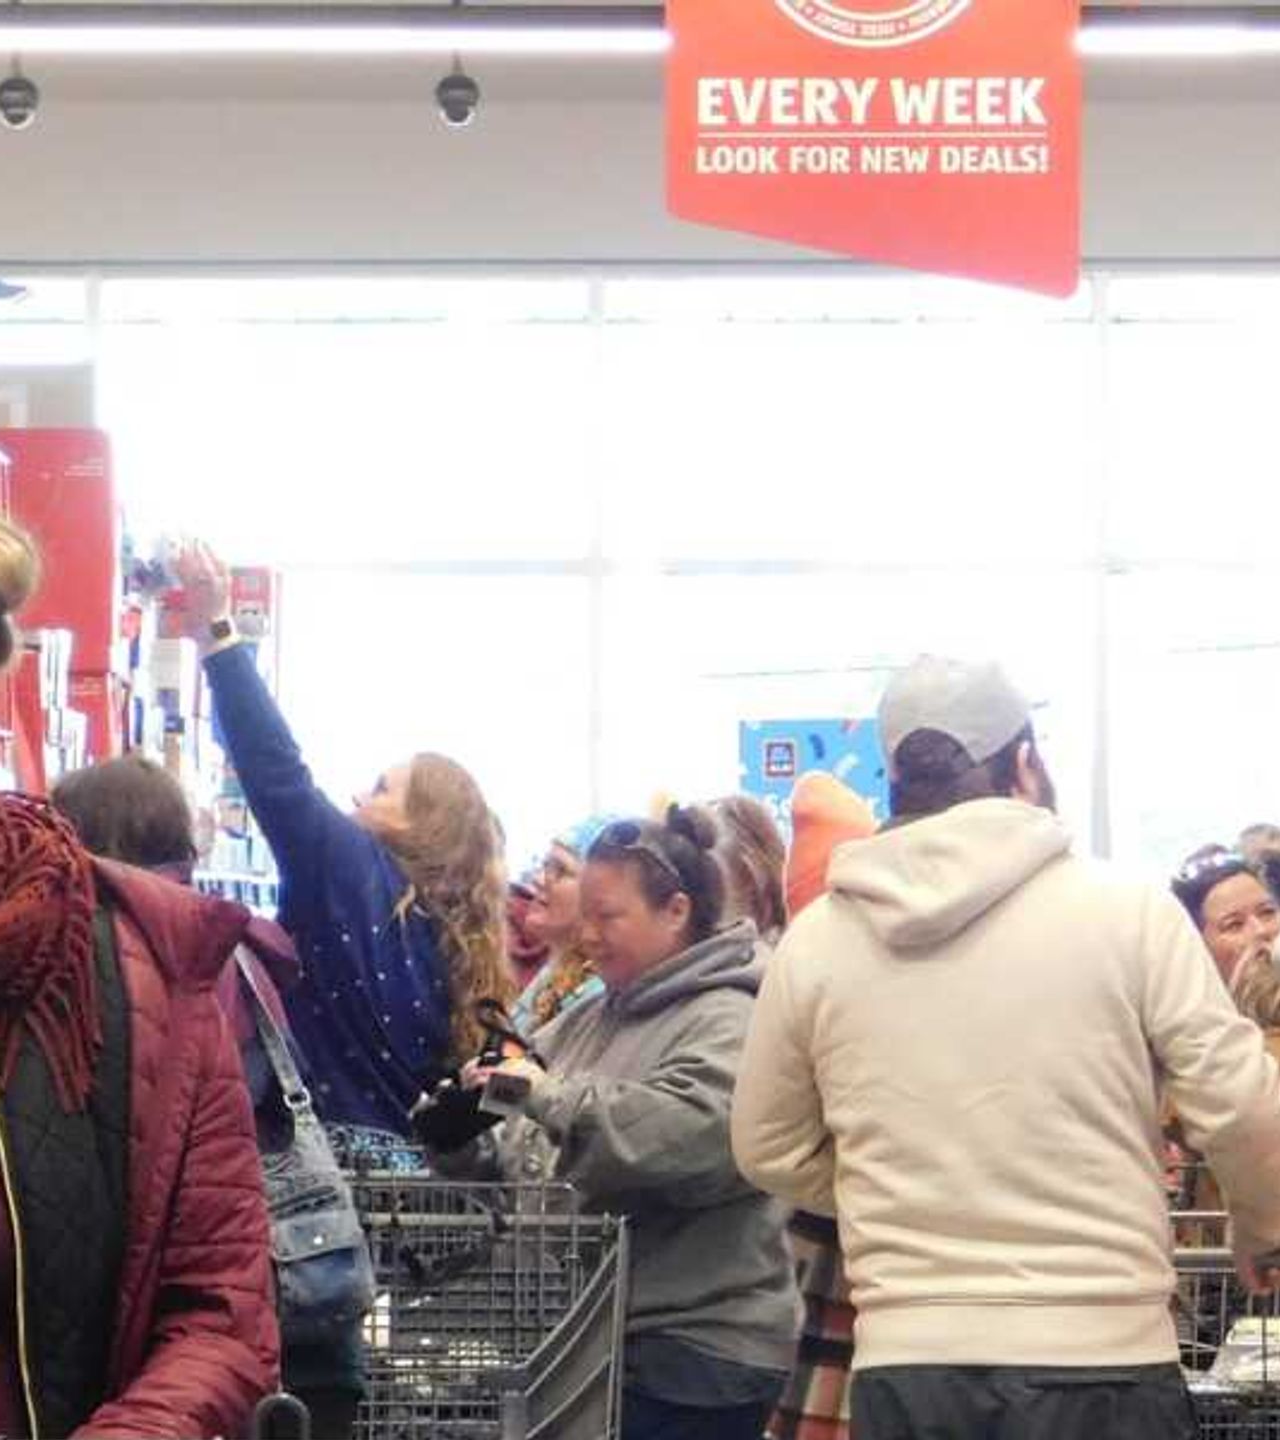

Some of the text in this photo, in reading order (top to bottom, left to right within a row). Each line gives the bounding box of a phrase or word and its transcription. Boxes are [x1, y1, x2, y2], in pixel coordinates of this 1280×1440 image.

[697, 76, 1048, 126] EVERY WEEK
[696, 145, 1050, 174] LOOK FOR NEW DEALS!
